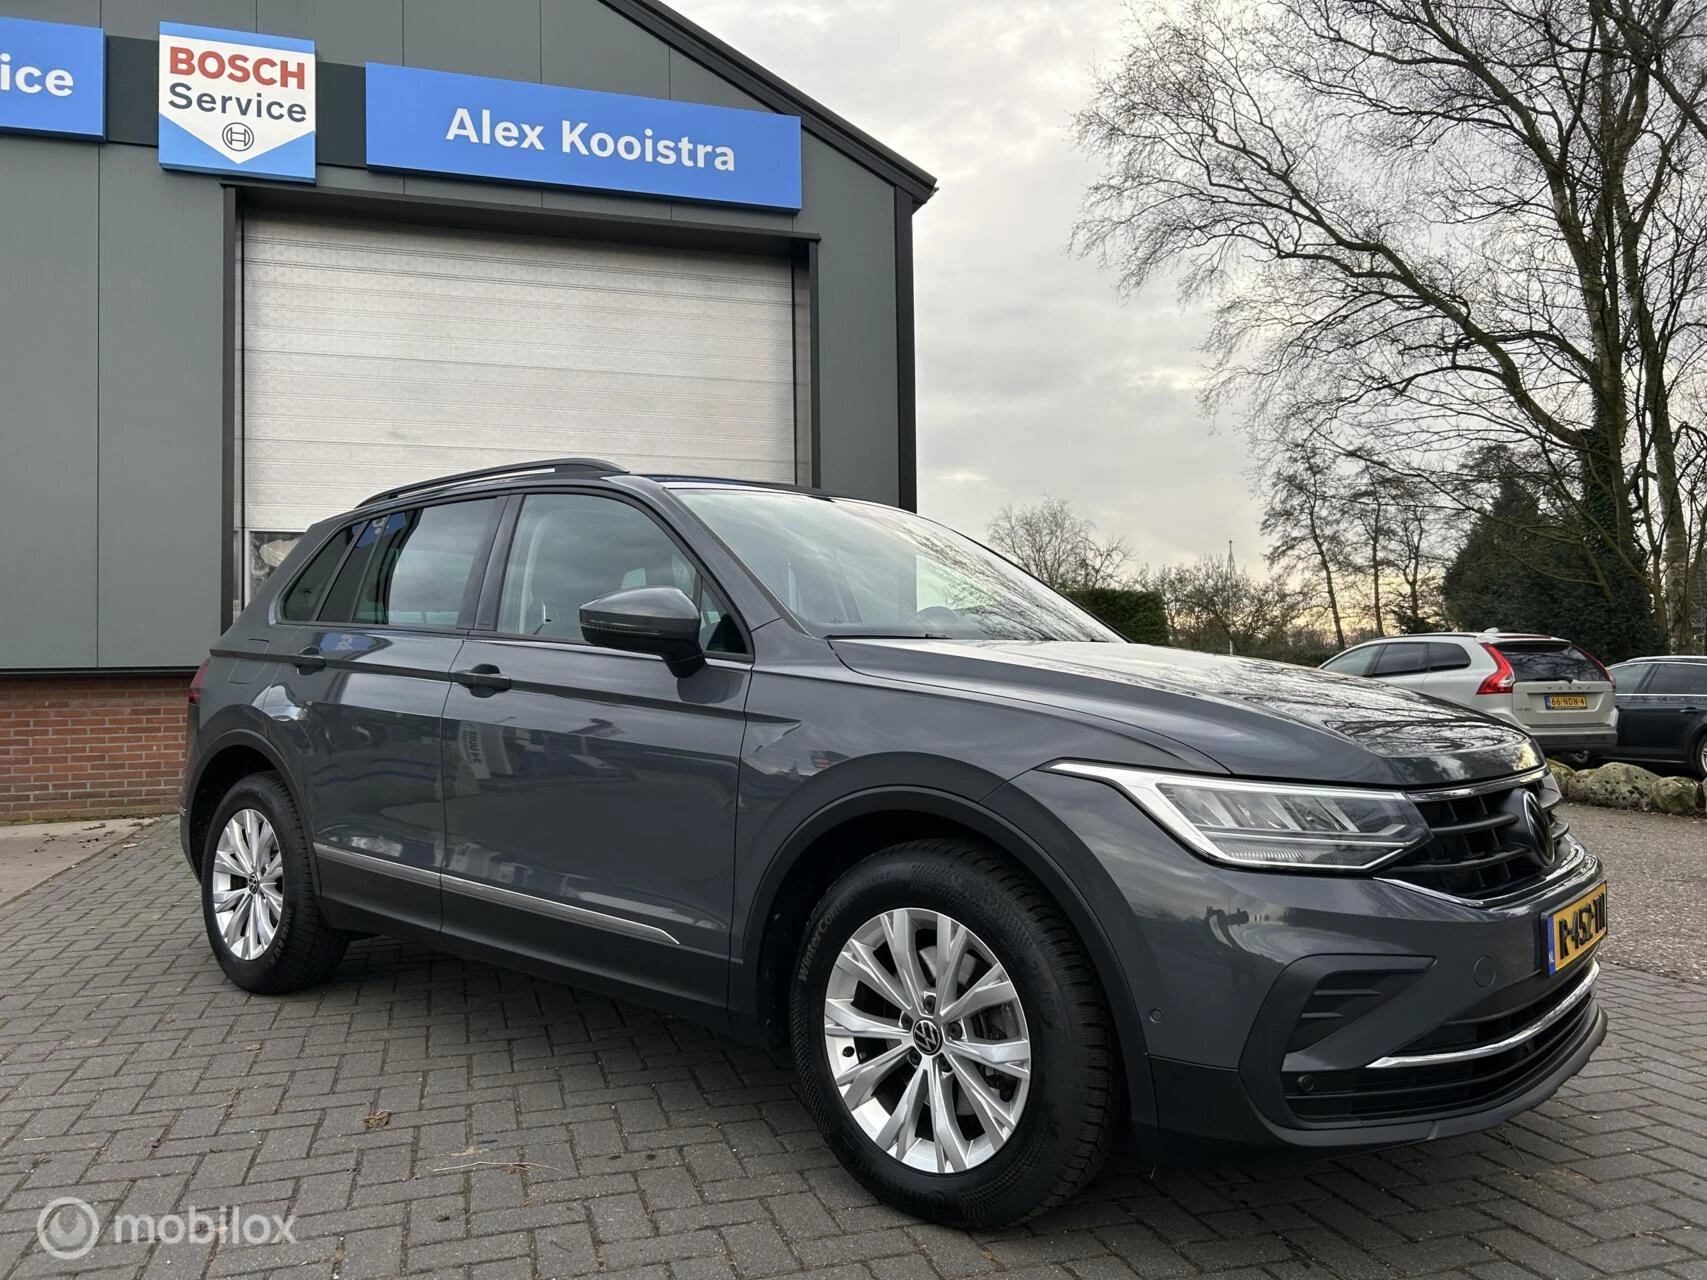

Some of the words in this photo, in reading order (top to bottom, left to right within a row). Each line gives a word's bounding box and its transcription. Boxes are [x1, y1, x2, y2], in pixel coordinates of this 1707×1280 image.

[169, 46, 305, 90] BOSCH
[168, 82, 307, 123] Service
[446, 108, 545, 151] Alex
[561, 119, 735, 172] Kooistra
